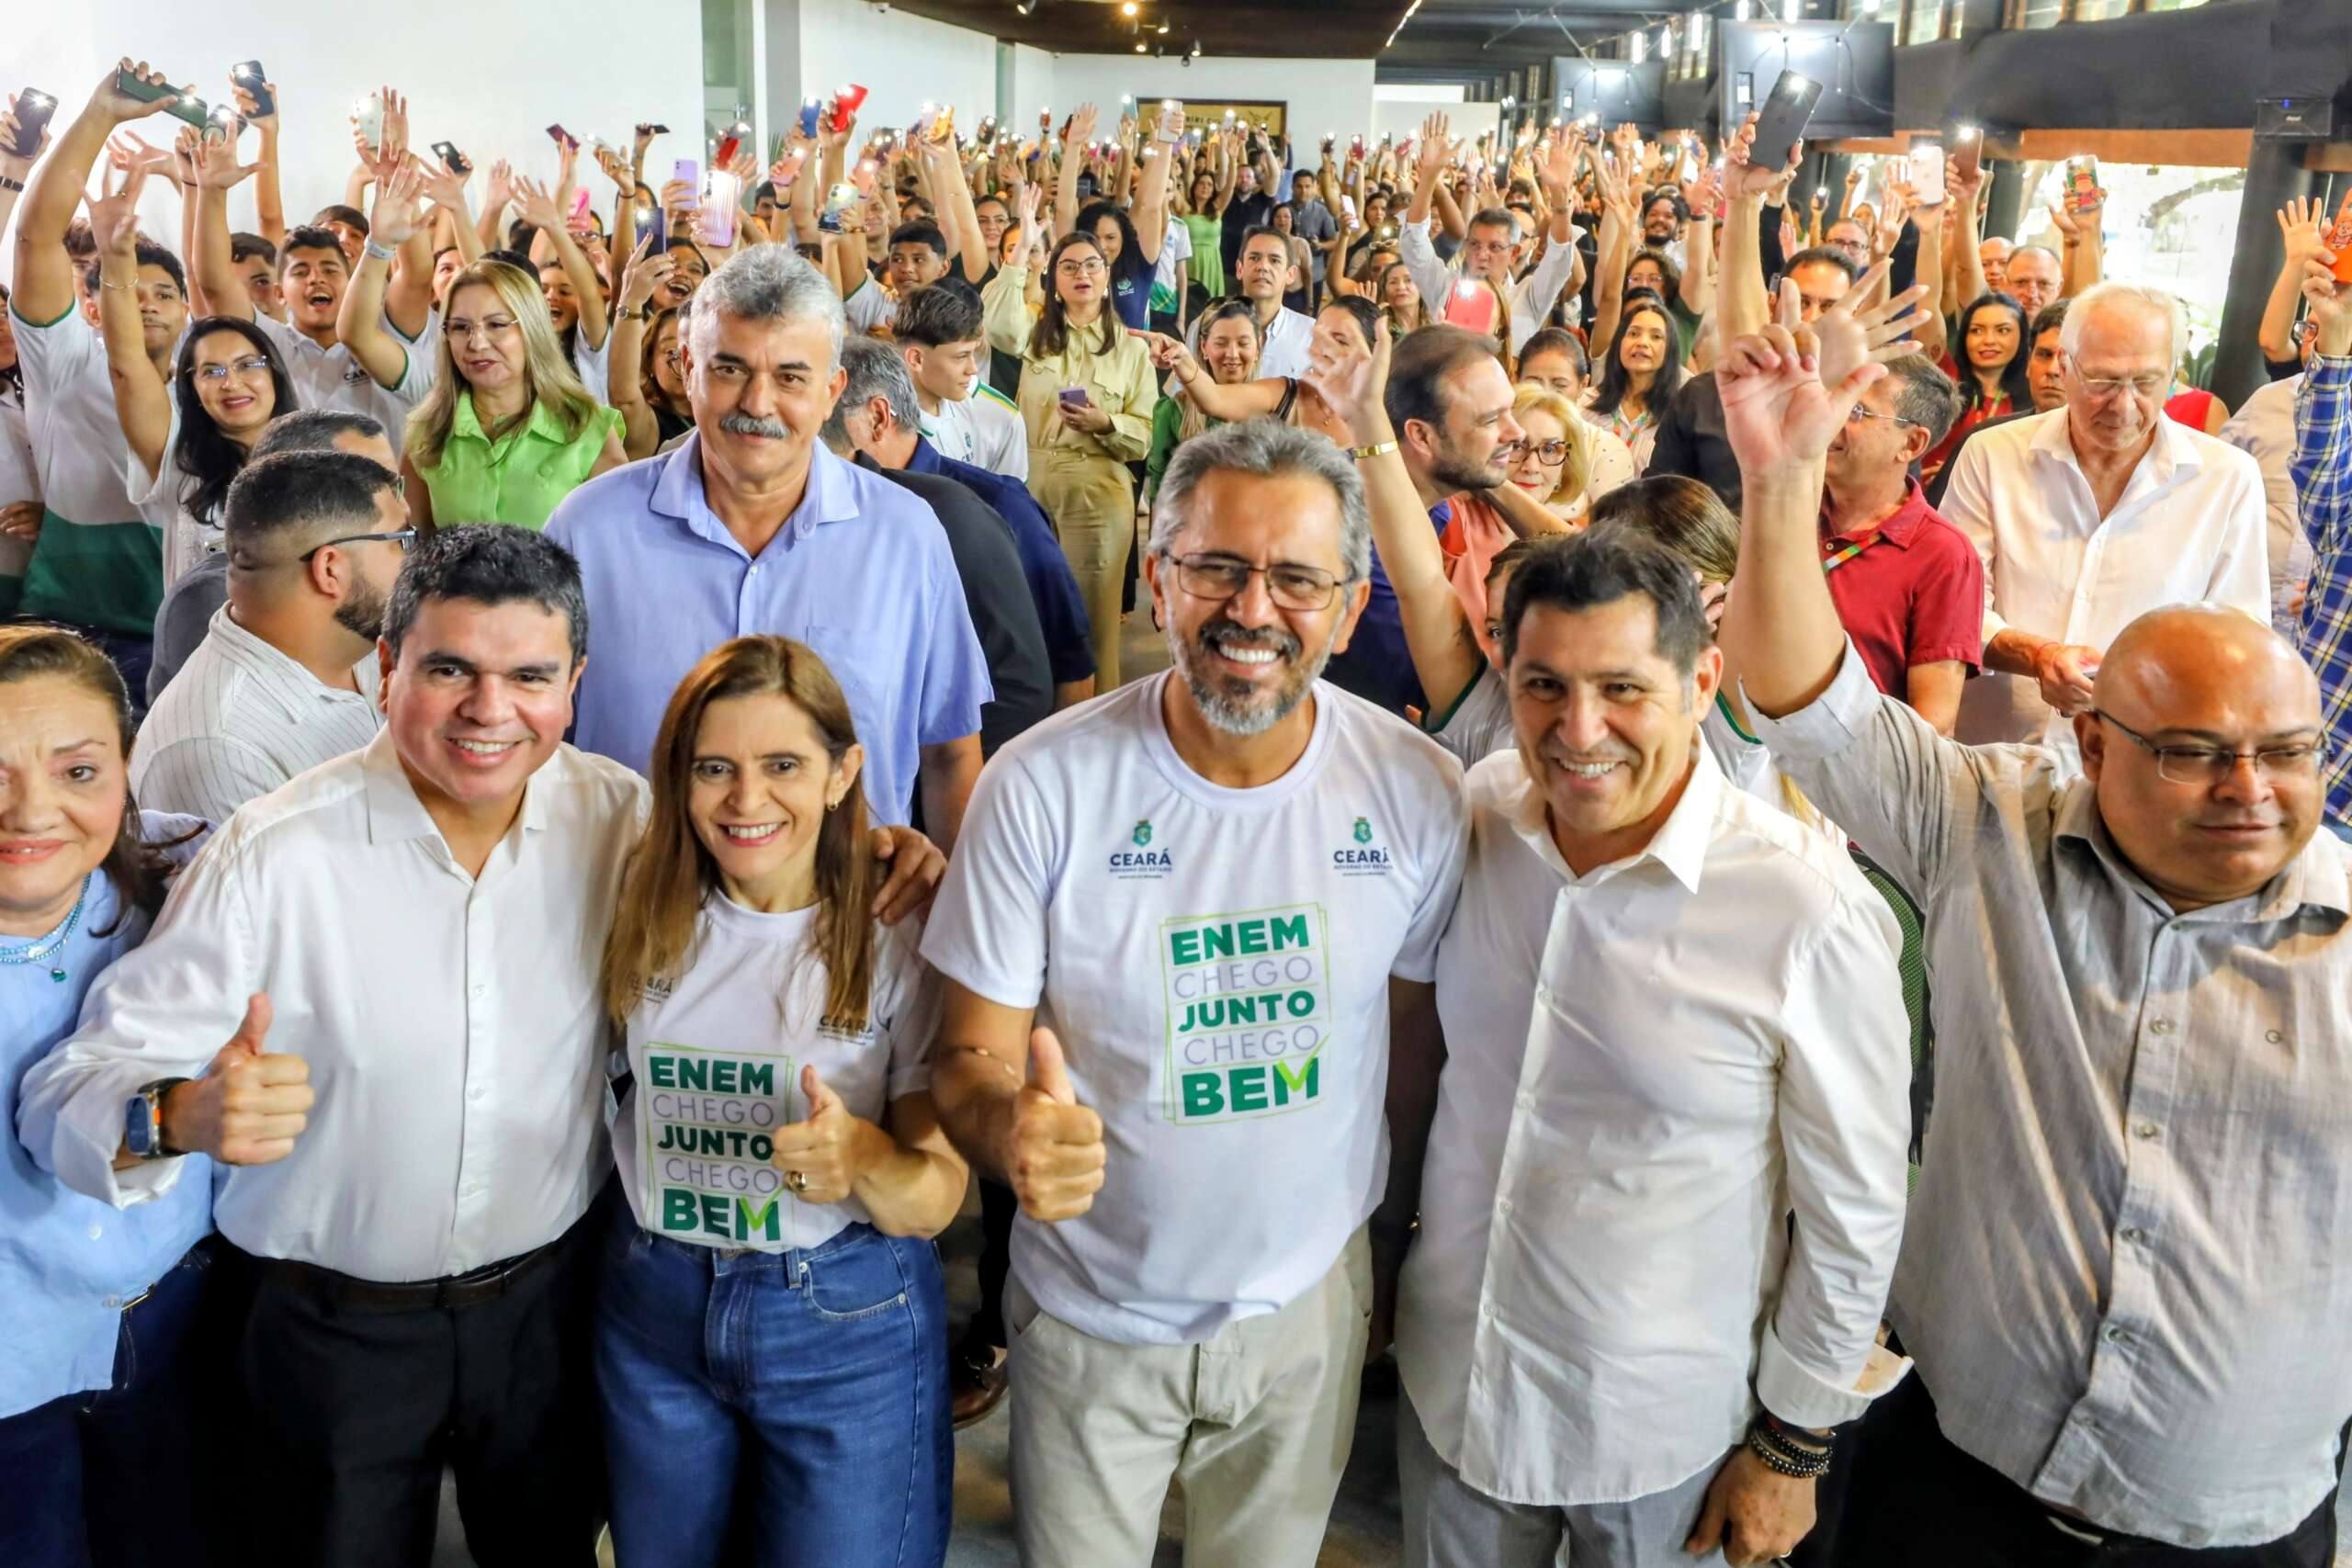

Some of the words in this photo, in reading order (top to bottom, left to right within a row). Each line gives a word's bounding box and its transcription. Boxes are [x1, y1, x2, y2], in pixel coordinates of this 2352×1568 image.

[1110, 848, 1171, 866] CEARÁ
[1333, 847, 1389, 863] CEARÁ
[1170, 914, 1309, 965] ENEM
[1174, 956, 1312, 999] CHEGO
[1178, 990, 1315, 1032] JUNTO
[1184, 1025, 1318, 1066] CHEGO
[650, 1056, 774, 1096] ENEM
[1182, 1057, 1319, 1117] BEM
[652, 1094, 775, 1126] CHEGO
[657, 1125, 775, 1161] JUNTO
[666, 1157, 778, 1194] CHEGO
[662, 1189, 781, 1241] BEM
